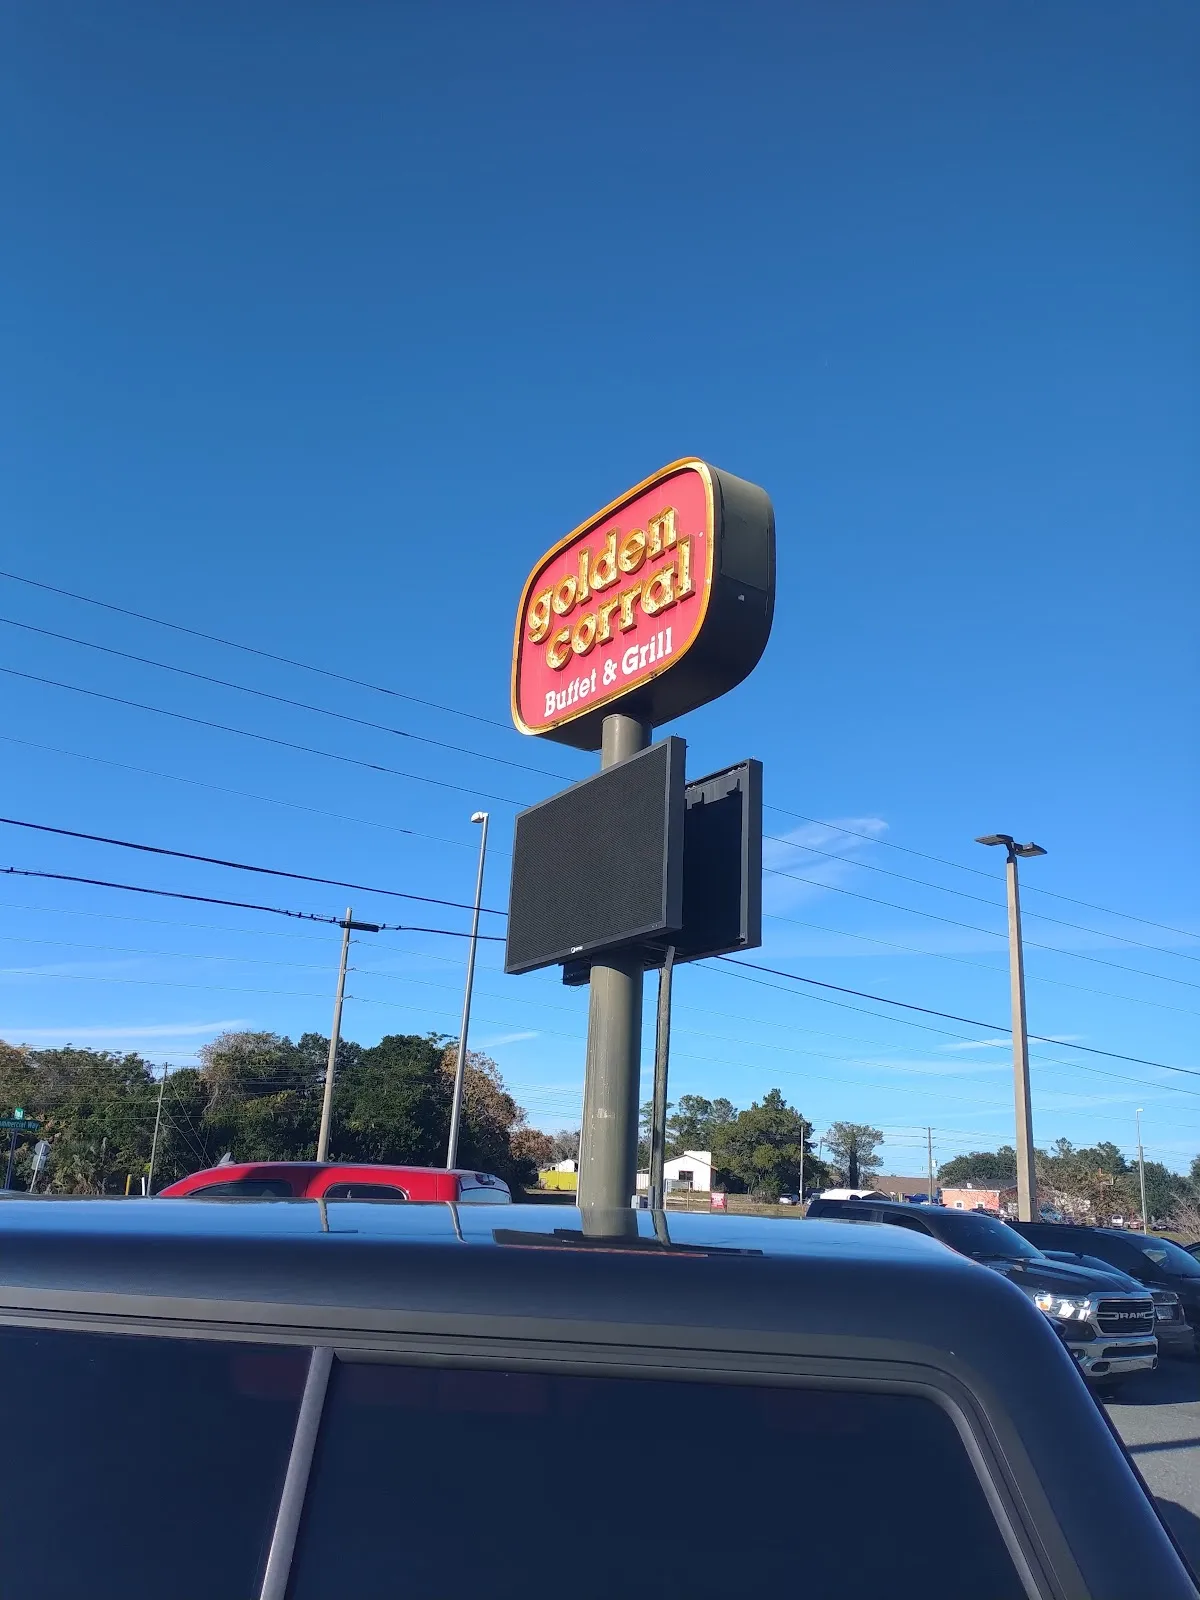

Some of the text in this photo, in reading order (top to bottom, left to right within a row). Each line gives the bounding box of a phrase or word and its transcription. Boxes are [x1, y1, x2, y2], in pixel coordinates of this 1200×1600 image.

[528, 505, 679, 644] golden
[546, 534, 696, 672] corral
[543, 627, 673, 718] Buffet & Grill
